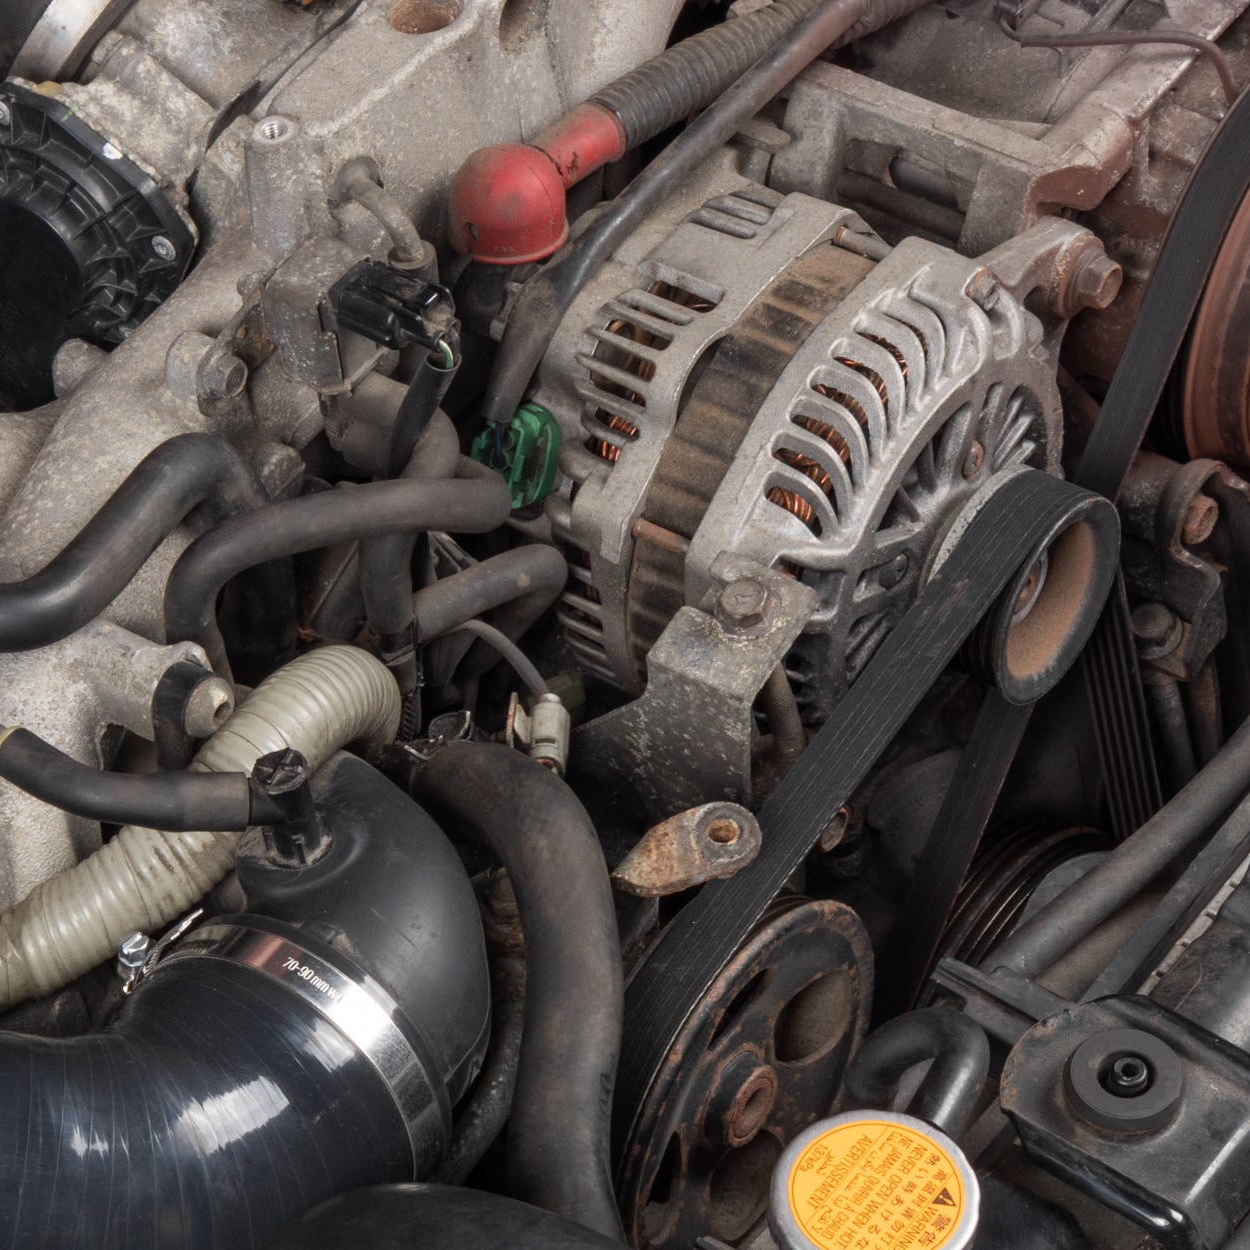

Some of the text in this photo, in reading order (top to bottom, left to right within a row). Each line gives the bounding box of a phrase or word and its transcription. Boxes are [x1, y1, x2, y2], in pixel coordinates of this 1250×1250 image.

[282, 956, 314, 981] 70-90
[309, 974, 329, 993] mm
[798, 1142, 828, 1174] 137kPa
[898, 1135, 913, 1150] NE
[806, 1134, 872, 1210] AVERTISSEMENT
[874, 1146, 903, 1177] JAMAIS
[898, 1143, 927, 1175] NEVER
[850, 1175, 879, 1207] OUVRIR
[876, 1173, 902, 1201] OPEN
[820, 1210, 849, 1242] CHAUD.
[852, 1199, 880, 1229] WHEN
[916, 1211, 952, 1250] 警告
